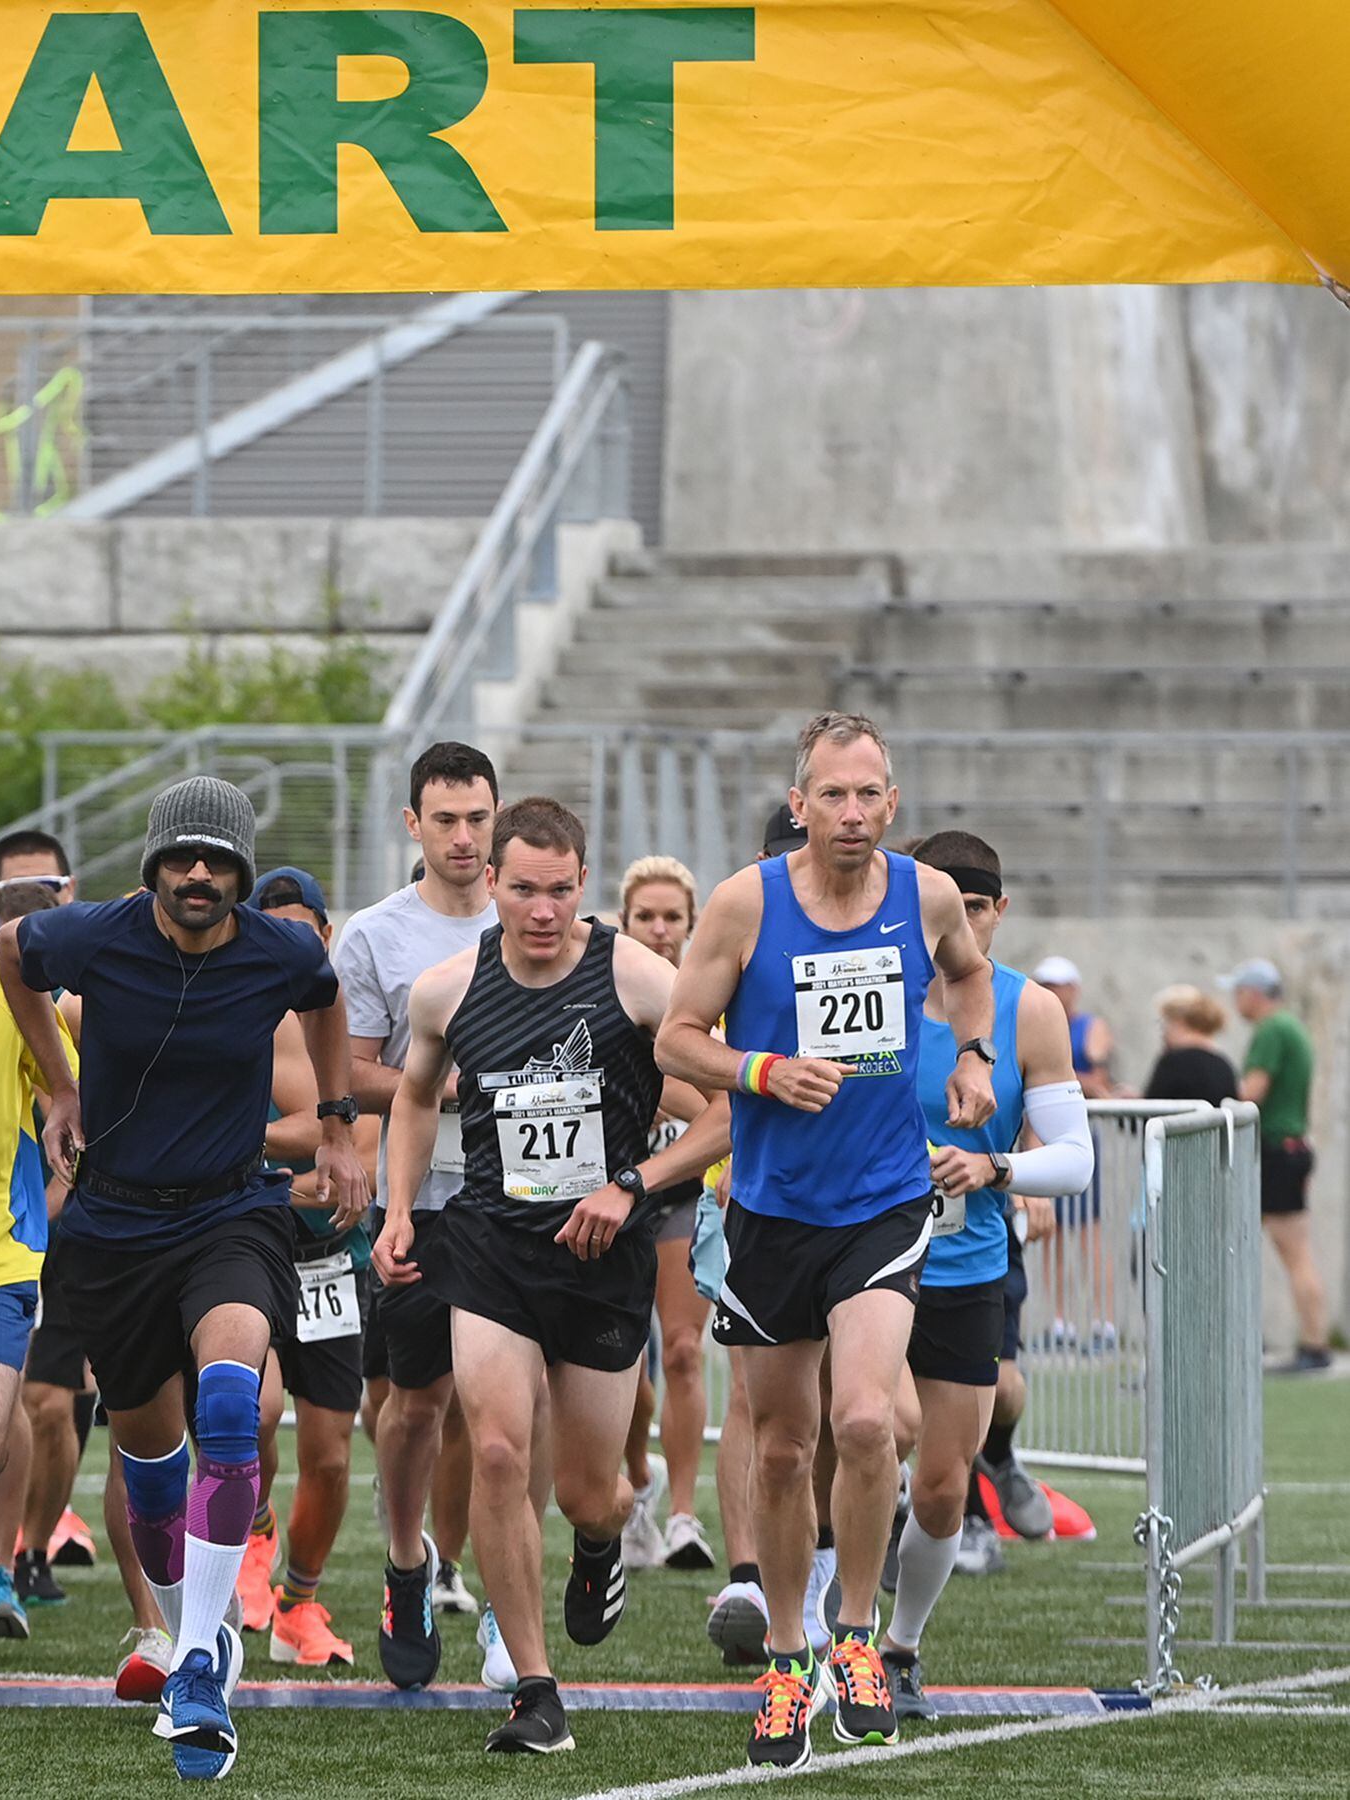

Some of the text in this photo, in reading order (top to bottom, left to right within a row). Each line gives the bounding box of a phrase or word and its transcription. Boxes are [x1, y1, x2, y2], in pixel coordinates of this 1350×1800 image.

[855, 976, 887, 986] MARATHON
[819, 990, 884, 1036] 220
[858, 1060, 898, 1074] ROJECT
[511, 1106, 586, 1119] 2021 MAYOR'S MARATHON
[518, 1119, 581, 1160] 217
[509, 1185, 559, 1196] SUBWAY
